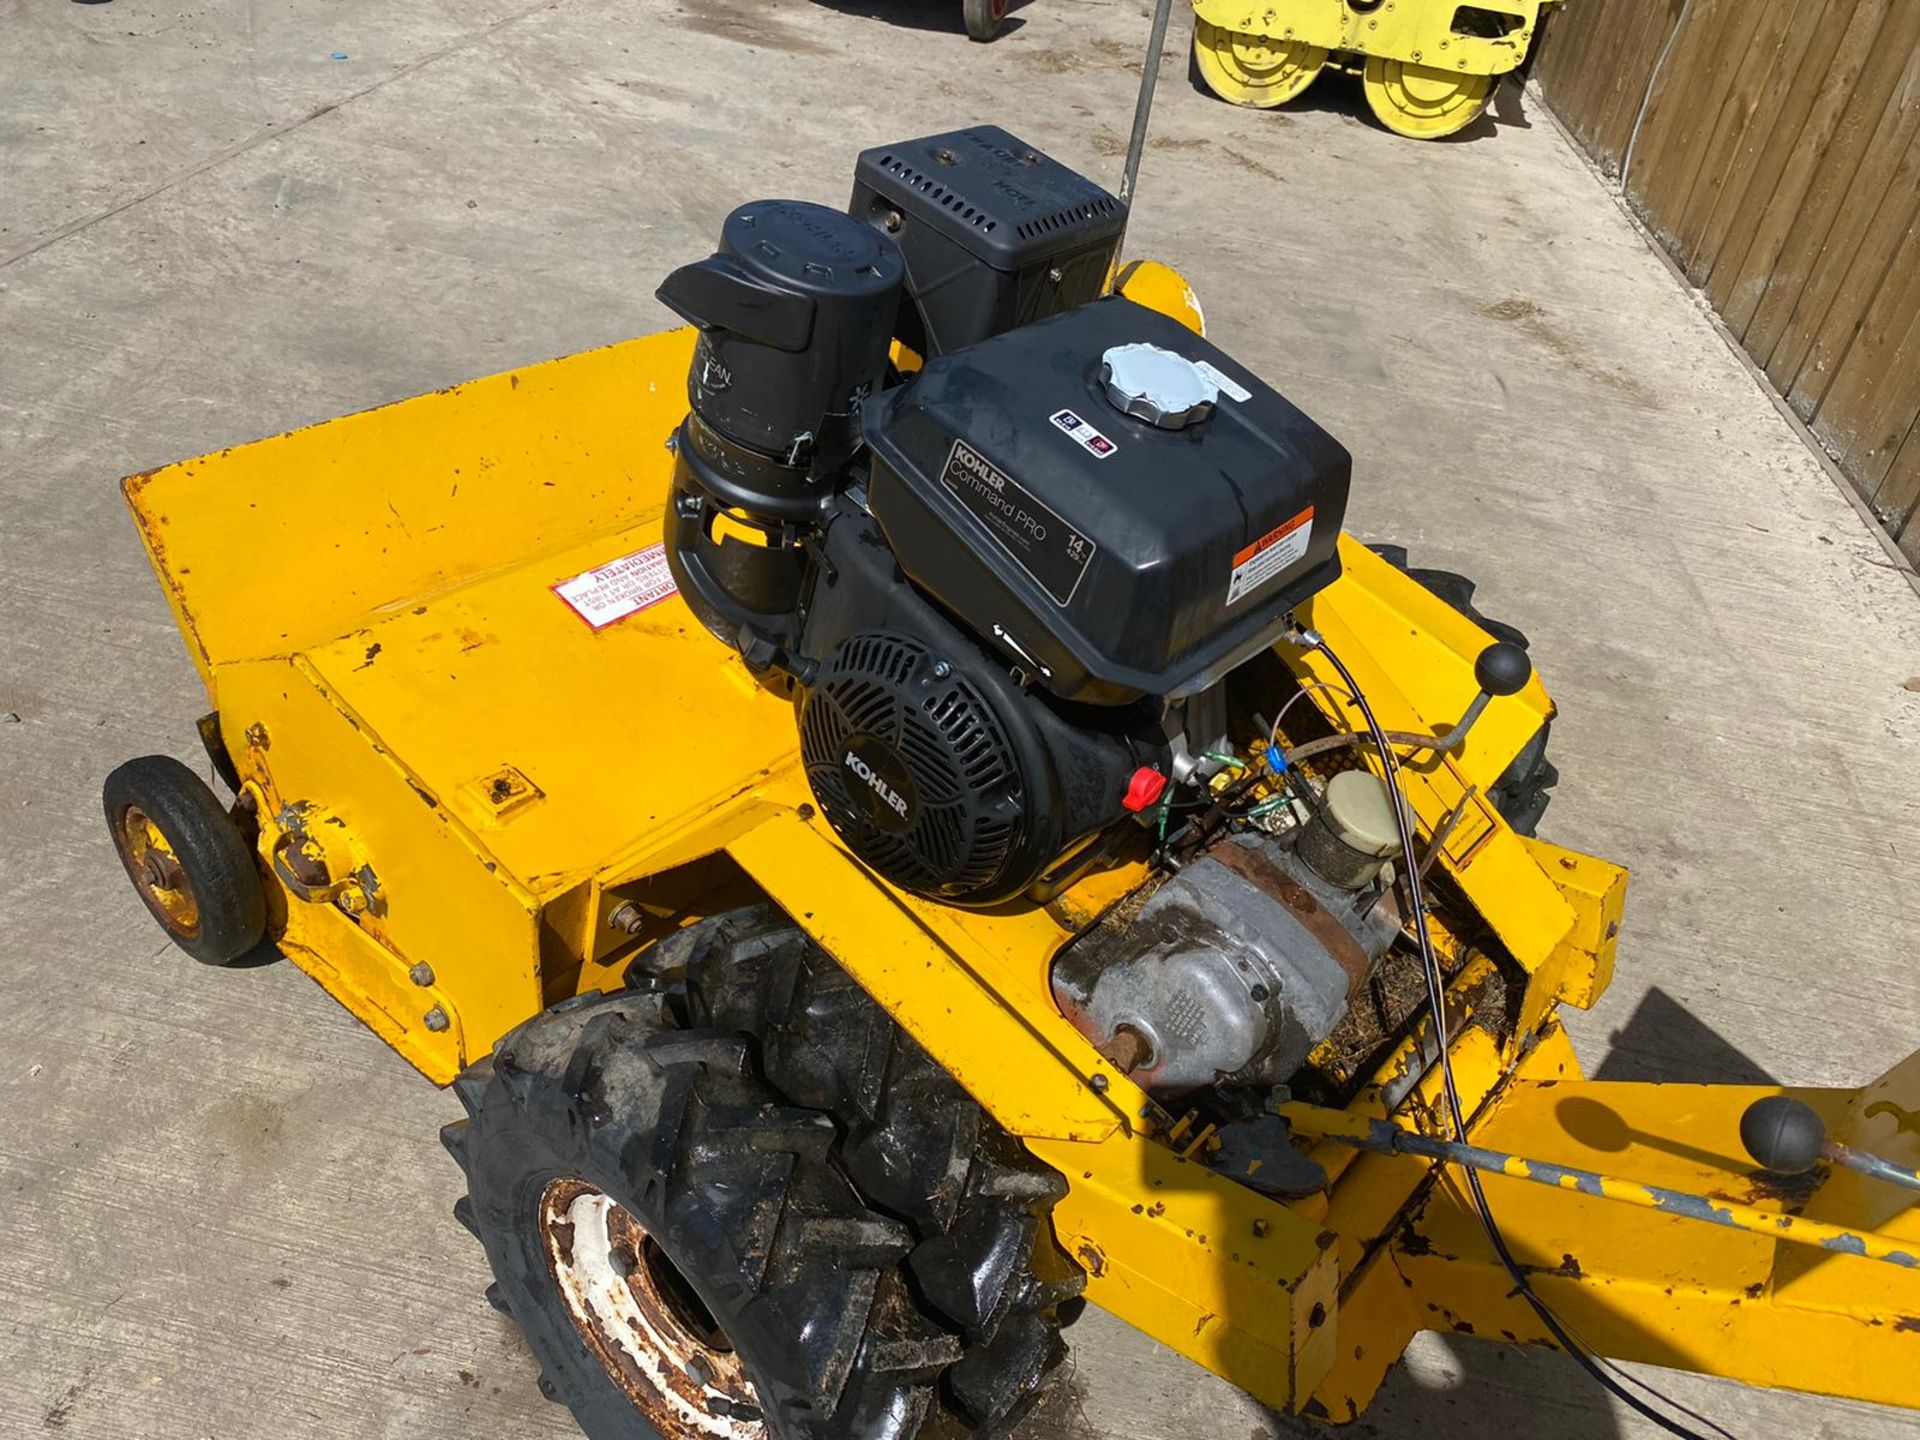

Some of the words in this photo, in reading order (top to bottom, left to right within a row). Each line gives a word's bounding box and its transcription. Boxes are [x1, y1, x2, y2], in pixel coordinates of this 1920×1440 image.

[955, 446, 1005, 494] KOHLER
[949, 460, 1015, 517] Command
[1015, 510, 1047, 542] PRO
[1068, 534, 1084, 554] 14
[633, 581, 675, 606] ORTANT
[845, 751, 908, 819] KOHLER
